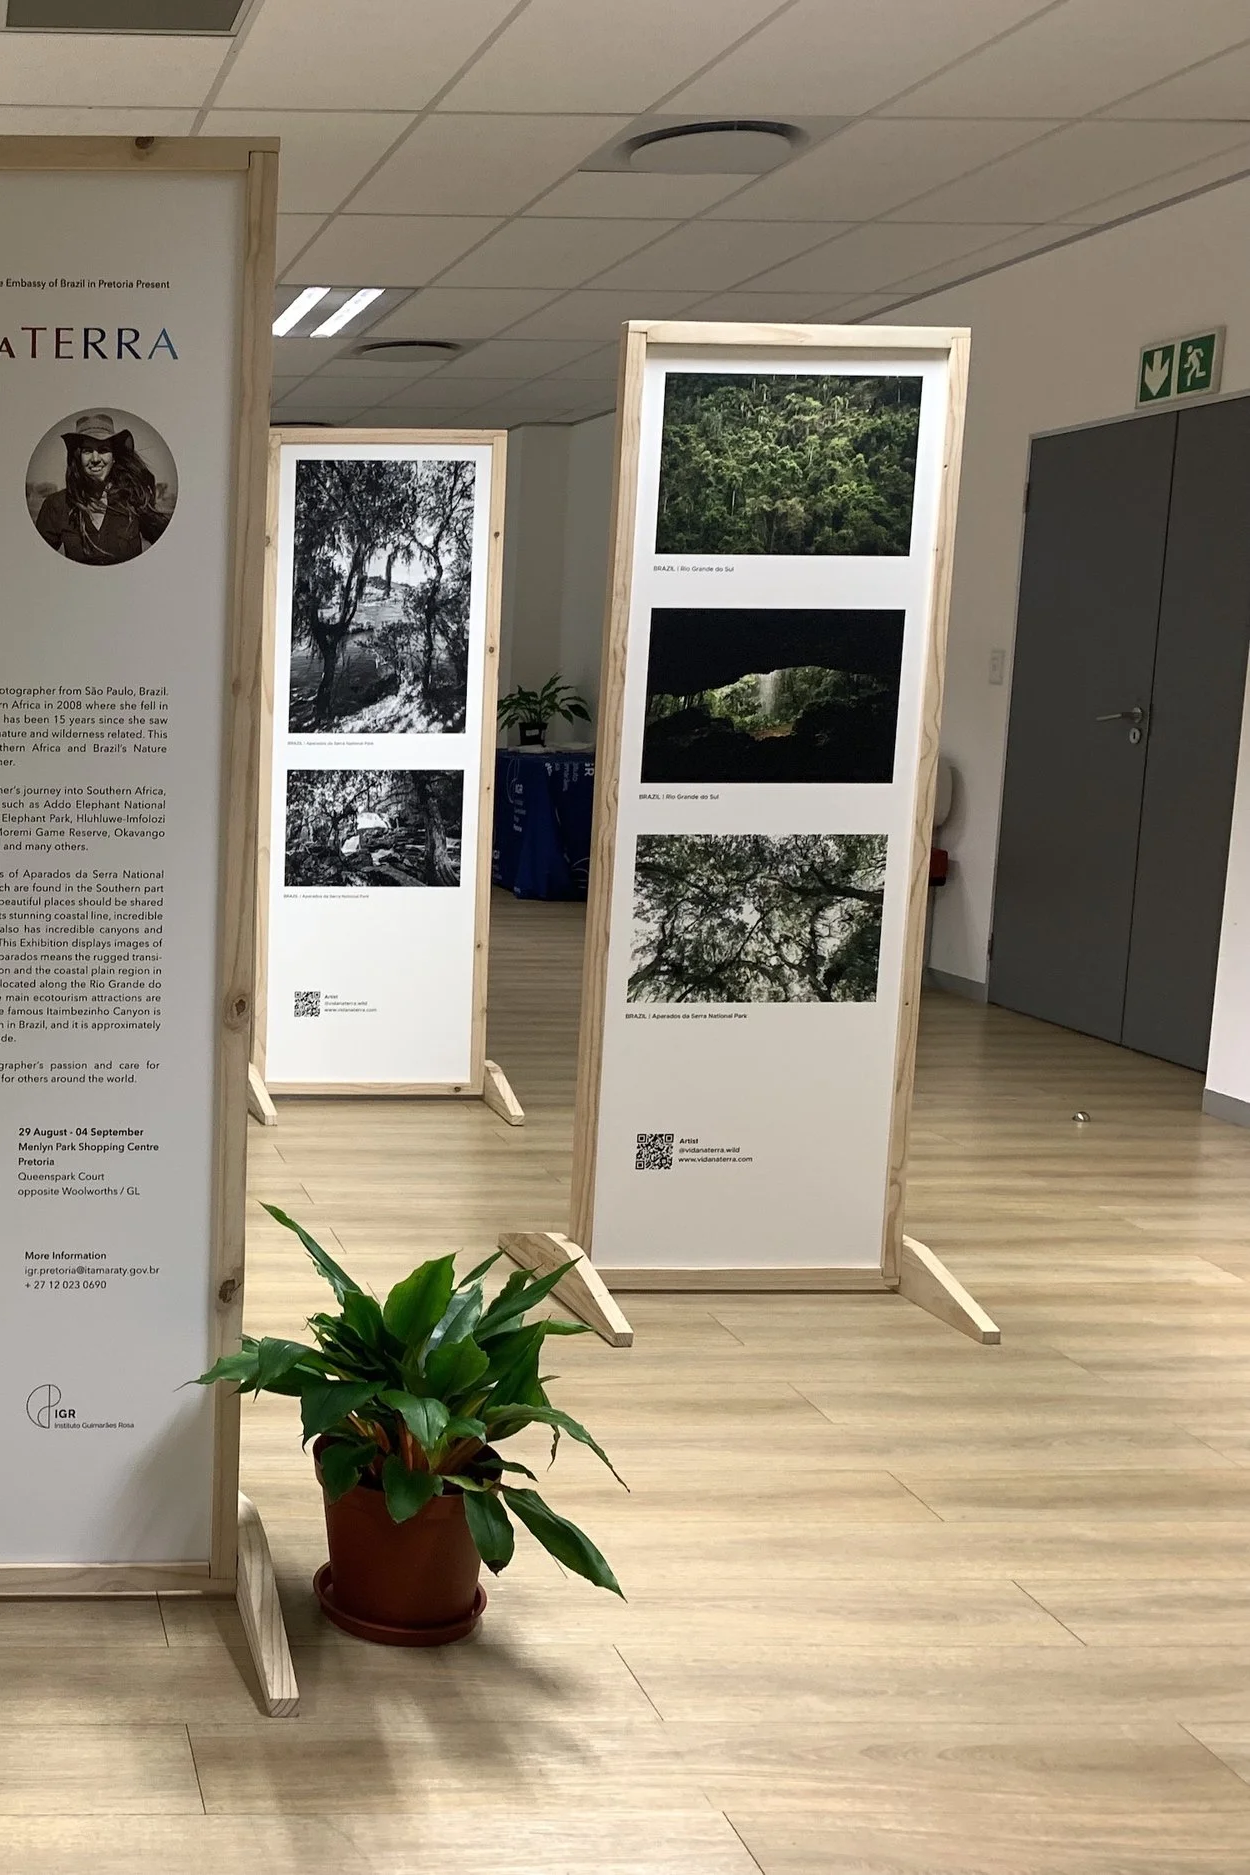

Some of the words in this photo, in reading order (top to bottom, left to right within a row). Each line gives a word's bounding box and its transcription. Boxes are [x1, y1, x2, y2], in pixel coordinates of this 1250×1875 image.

[5, 277, 46, 289] Embassy
[48, 278, 58, 287] of
[60, 278, 84, 288] Brazil
[87, 279, 95, 288] in
[98, 279, 133, 288] Pretoria
[136, 279, 169, 288] Present
[58, 685, 81, 695] from
[85, 686, 103, 695] São
[106, 686, 135, 696] Paulo,
[139, 686, 168, 696] Brazil.
[18, 1127, 31, 1136] 29
[33, 1127, 67, 1138] August
[75, 1127, 87, 1136] 04
[90, 1127, 143, 1138] September
[18, 1142, 53, 1153] Menlyn
[55, 1142, 76, 1151] Park
[78, 1142, 124, 1153] Shopping
[127, 1142, 159, 1151] Centre
[24, 1251, 49, 1260] More
[52, 1250, 106, 1260] Information
[24, 1265, 159, 1277] igr.pretoria@itamaraty.gov.br
[34, 1280, 45, 1289] 27
[49, 1280, 60, 1289] 12
[62, 1280, 80, 1289] 023
[82, 1280, 106, 1289] 0690
[54, 1408, 75, 1418] IGR
